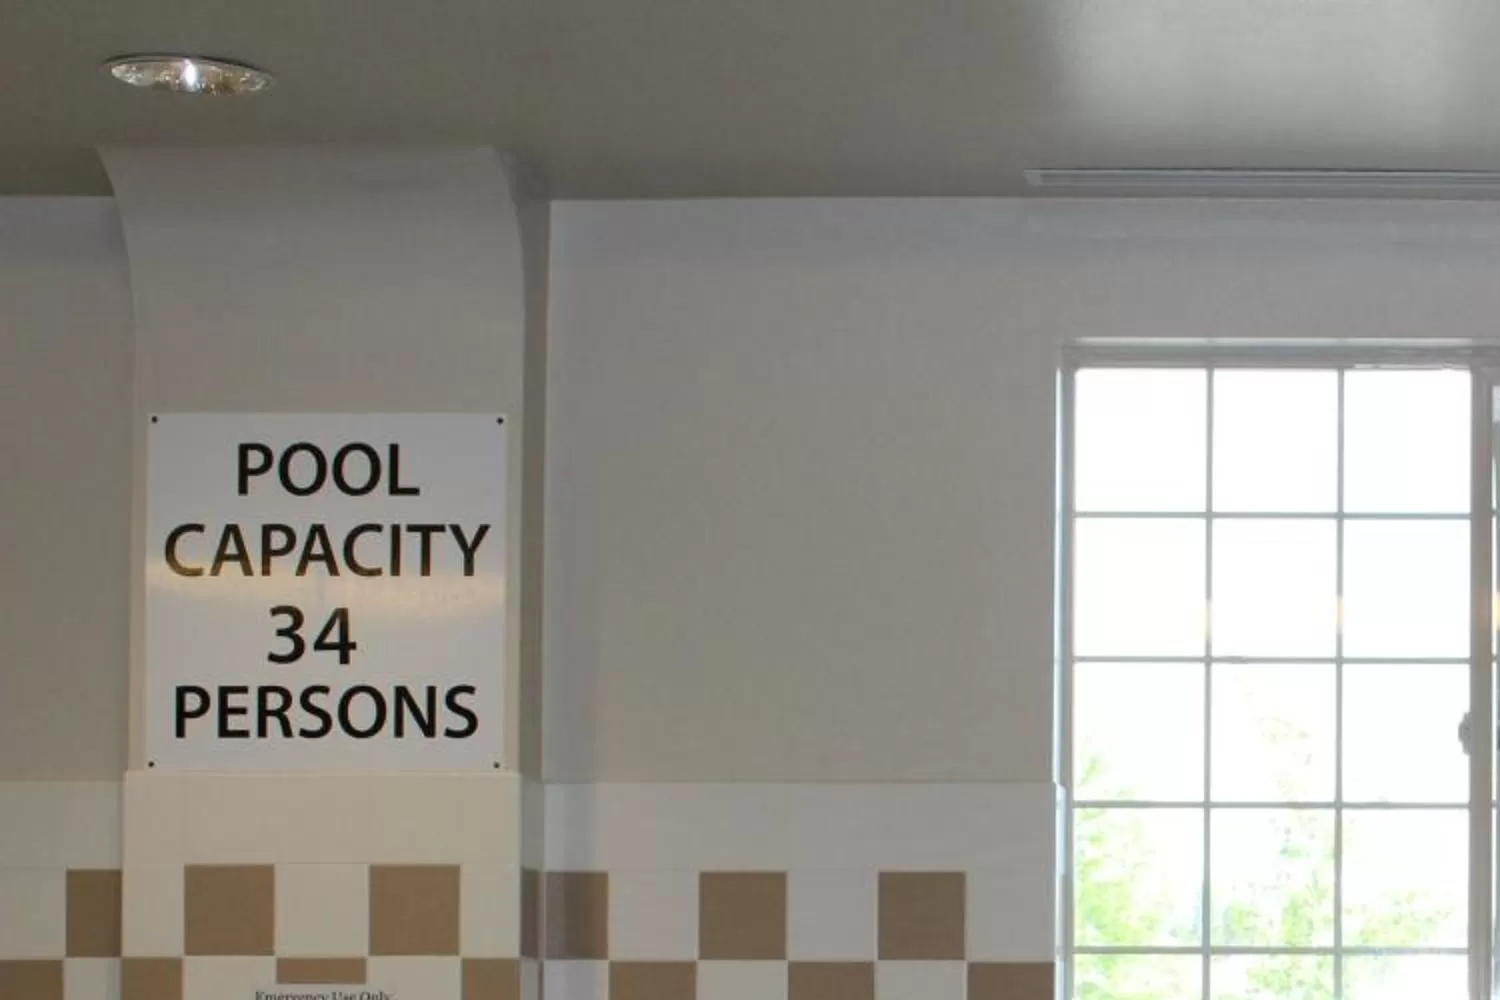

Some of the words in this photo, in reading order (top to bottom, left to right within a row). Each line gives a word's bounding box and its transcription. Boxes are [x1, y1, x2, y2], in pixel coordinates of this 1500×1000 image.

[238, 443, 420, 496] POOL
[164, 523, 491, 577] CAPACITY
[267, 605, 357, 665] 34
[174, 684, 479, 739] PERSONS
